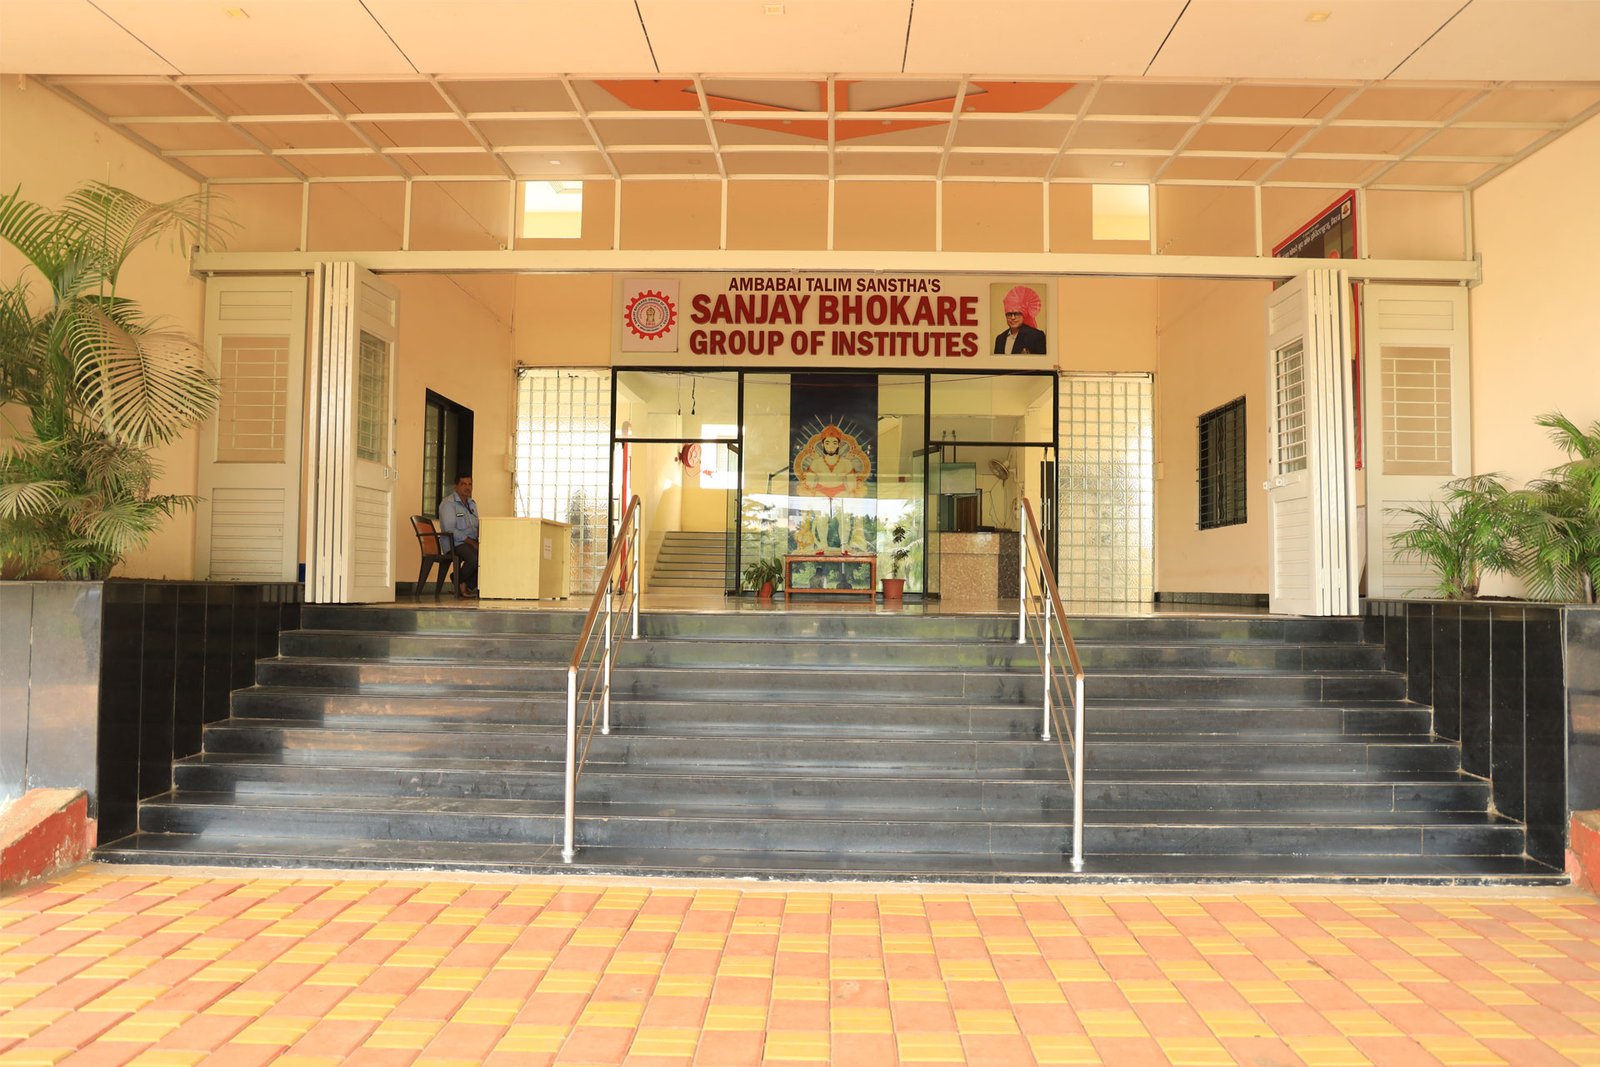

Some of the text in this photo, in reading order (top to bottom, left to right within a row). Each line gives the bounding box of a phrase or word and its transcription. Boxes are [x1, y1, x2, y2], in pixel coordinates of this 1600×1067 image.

[728, 277, 941, 293] AMBABAI TALIM SANSTHA'S
[690, 293, 811, 326] SANJAY
[818, 294, 979, 327] BHOKARE
[689, 329, 979, 358] GROUP OF INSTITUTES
